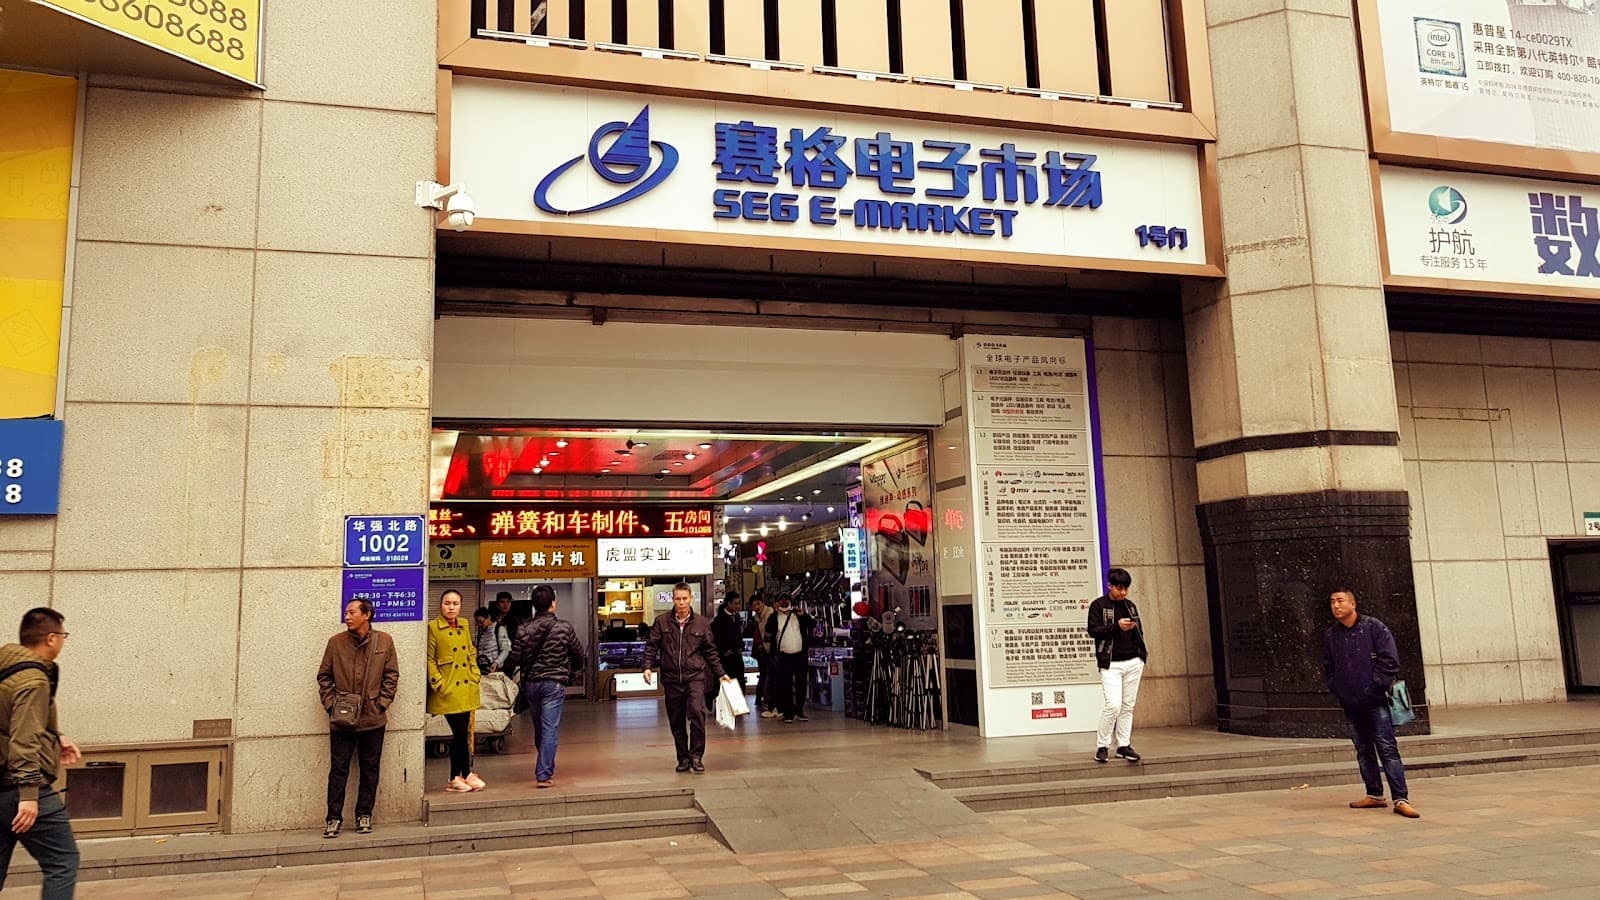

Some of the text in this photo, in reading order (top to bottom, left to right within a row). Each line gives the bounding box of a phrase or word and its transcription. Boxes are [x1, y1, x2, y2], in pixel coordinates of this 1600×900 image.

[168, 0, 248, 31] 688
[1430, 32, 1448, 42] intel
[1472, 22, 1573, 48] 惠普星 14-ce0029TX
[1426, 48, 1447, 58] CORE
[711, 120, 1103, 210] 赛格电子市场
[713, 188, 1019, 239] SEG E-MARKET
[1134, 224, 1189, 250] 1号门
[1428, 227, 1475, 256] 护航
[1527, 191, 1600, 279] 数
[1420, 255, 1489, 271] 专注服务 15 年
[0, 458, 23, 478] 8
[353, 520, 417, 532] 华强北路
[359, 534, 409, 553] 1002
[606, 547, 671, 562] 虎盟实业
[387, 591, 416, 599] 下午6:30
